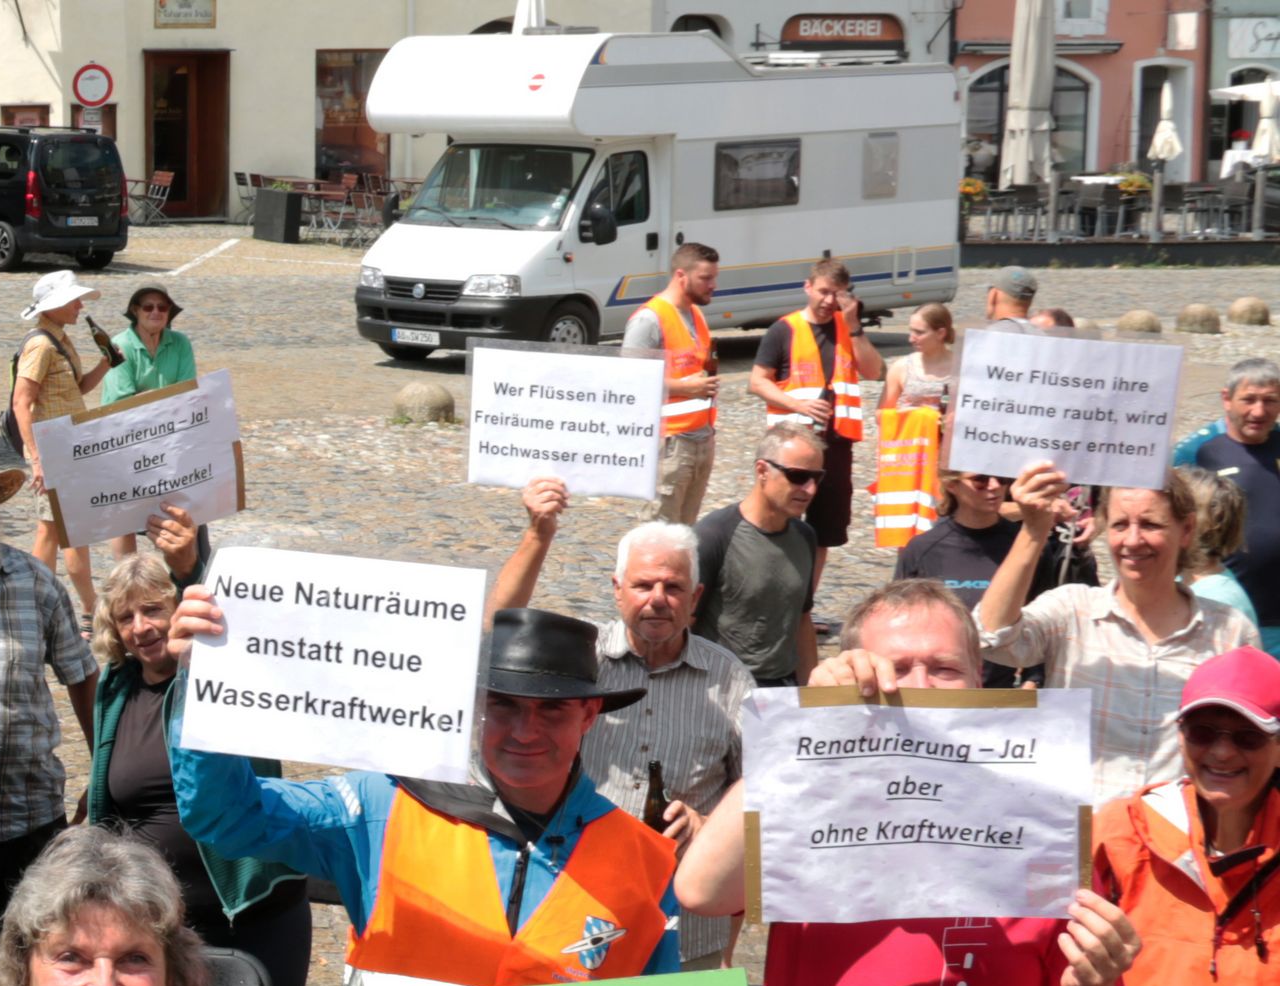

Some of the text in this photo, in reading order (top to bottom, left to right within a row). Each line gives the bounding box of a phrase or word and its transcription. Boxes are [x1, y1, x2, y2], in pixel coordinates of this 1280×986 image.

[799, 19, 882, 36] BÄCKEREI
[987, 365, 1149, 392] Wer Flüssen ihre
[494, 382, 636, 405] Wer Flüssen ihre
[961, 394, 1167, 425] Freiräume raubt, wird
[73, 407, 208, 457] Renaturierung Ja!
[475, 410, 654, 437] Freiräume raubt, wird
[479, 441, 645, 467] Hochwasser ernten!
[964, 426, 1155, 456] Hochwasser ernten!
[134, 453, 165, 470] aber
[90, 464, 212, 505] ohne Kraftwerke!
[214, 575, 467, 621] Neue Naturräume
[246, 636, 422, 672] anstatt neue
[195, 678, 464, 733] Wasserkraftwerke!
[797, 734, 1036, 762] Renaturierung Ja!
[887, 776, 943, 796] aber
[811, 819, 1024, 845] ohne Kraftwerke!
